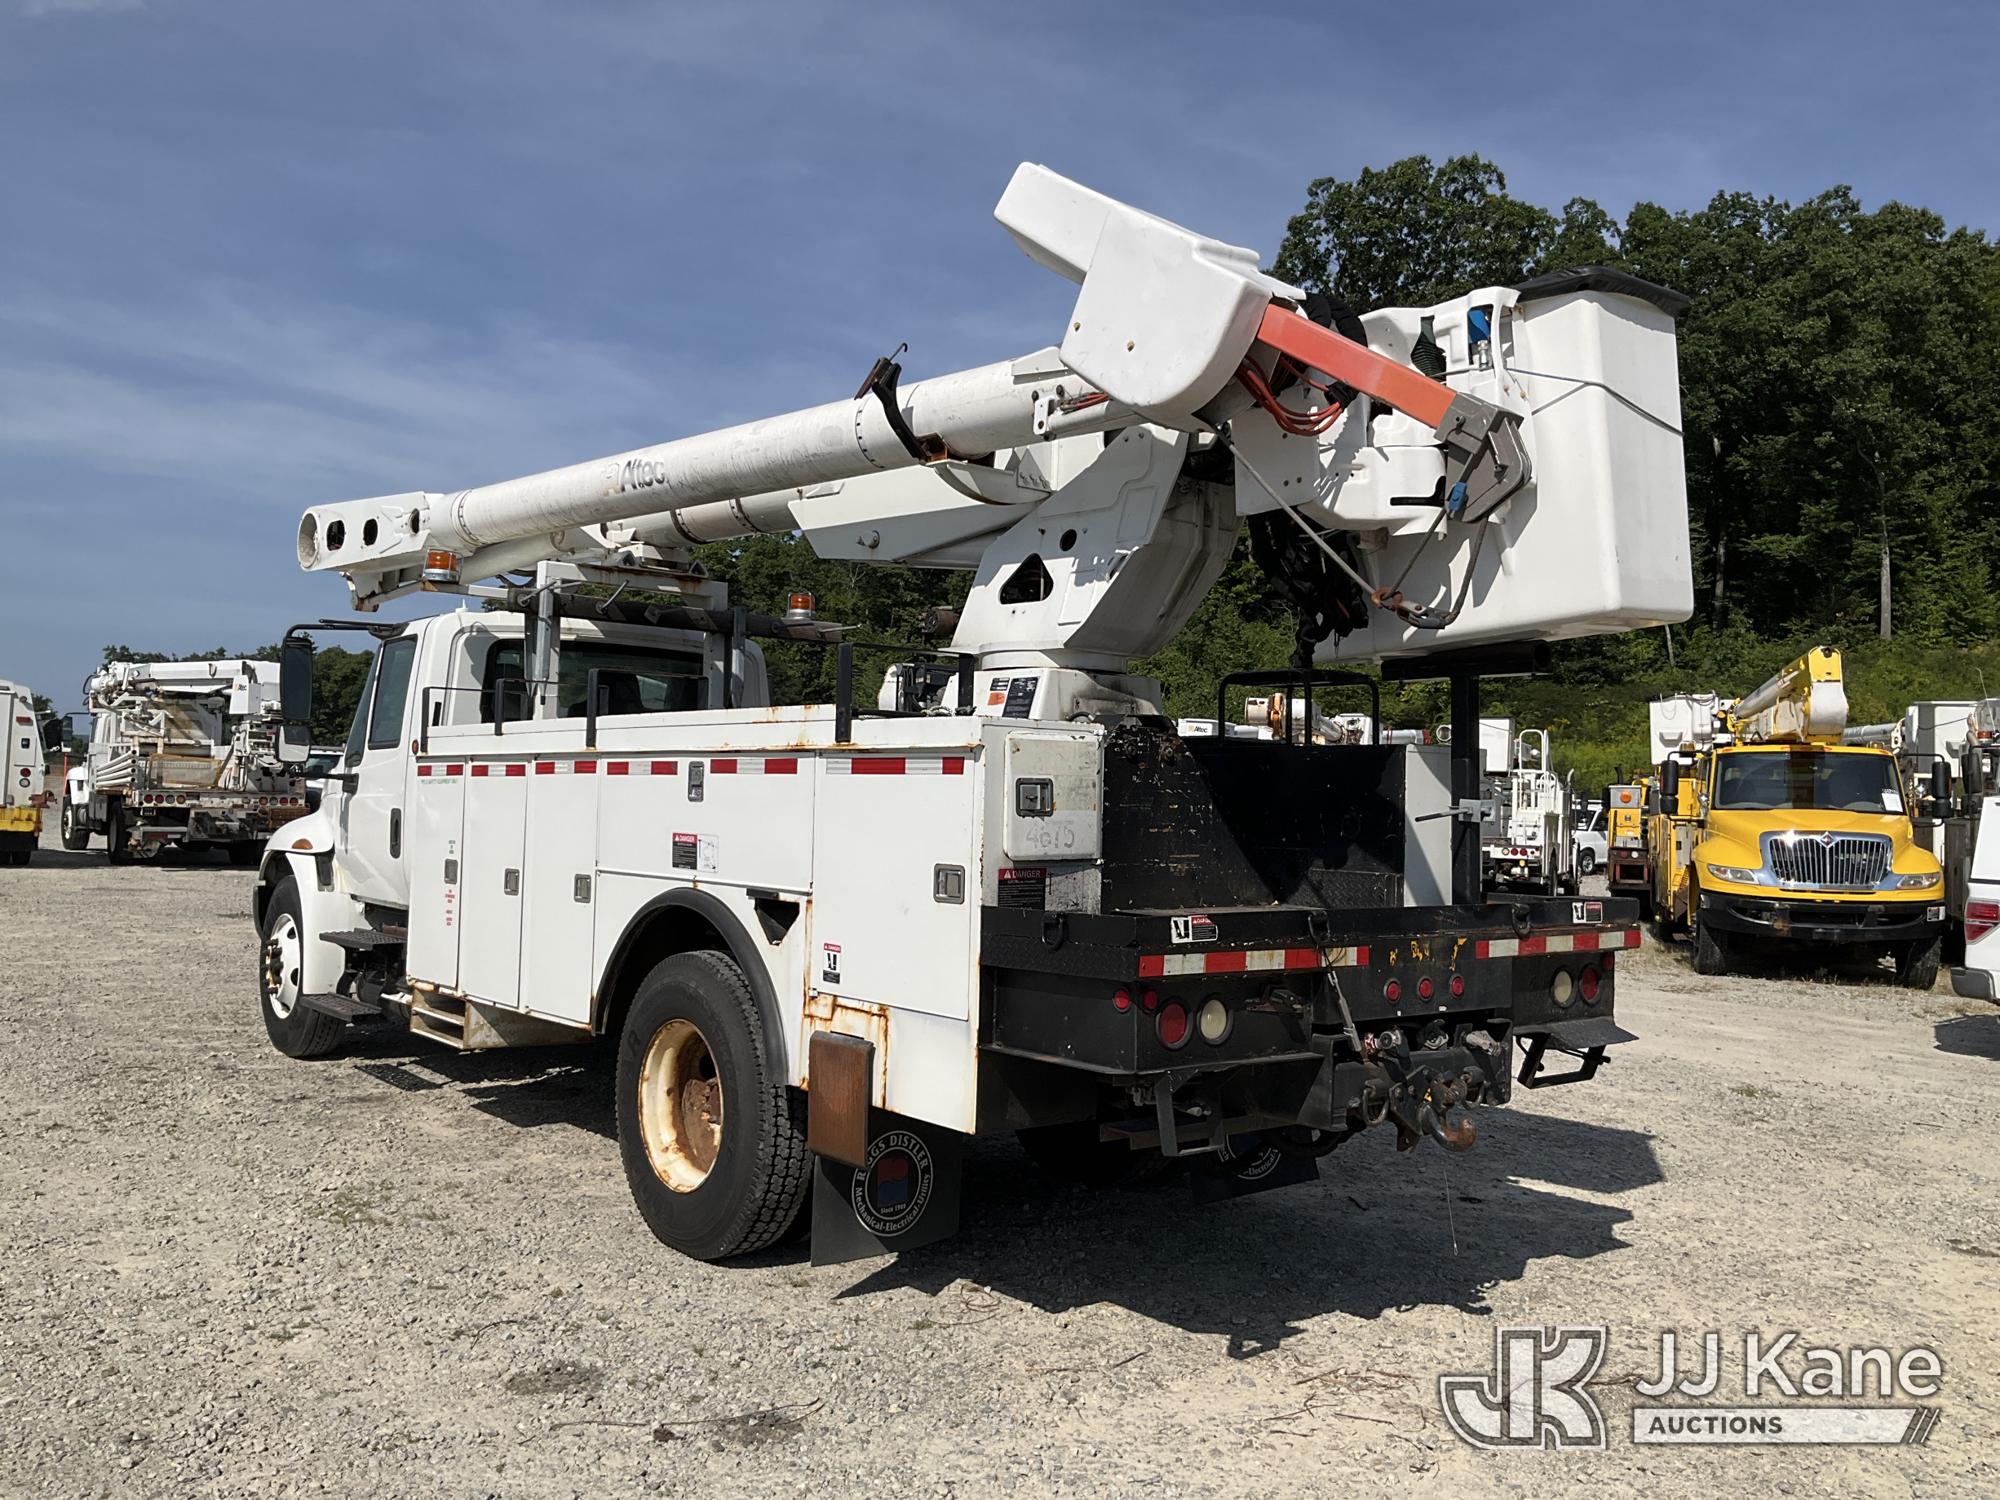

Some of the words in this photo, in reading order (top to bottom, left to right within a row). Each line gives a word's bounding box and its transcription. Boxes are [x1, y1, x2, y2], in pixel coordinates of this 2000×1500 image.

[621, 459, 665, 492] Altec
[1012, 870, 1041, 879] DANGER
[857, 1140, 886, 1181] RGS
[890, 1134, 929, 1169] DISTLER
[856, 1187, 883, 1231] Mechanical
[885, 1207, 919, 1232] Electrical
